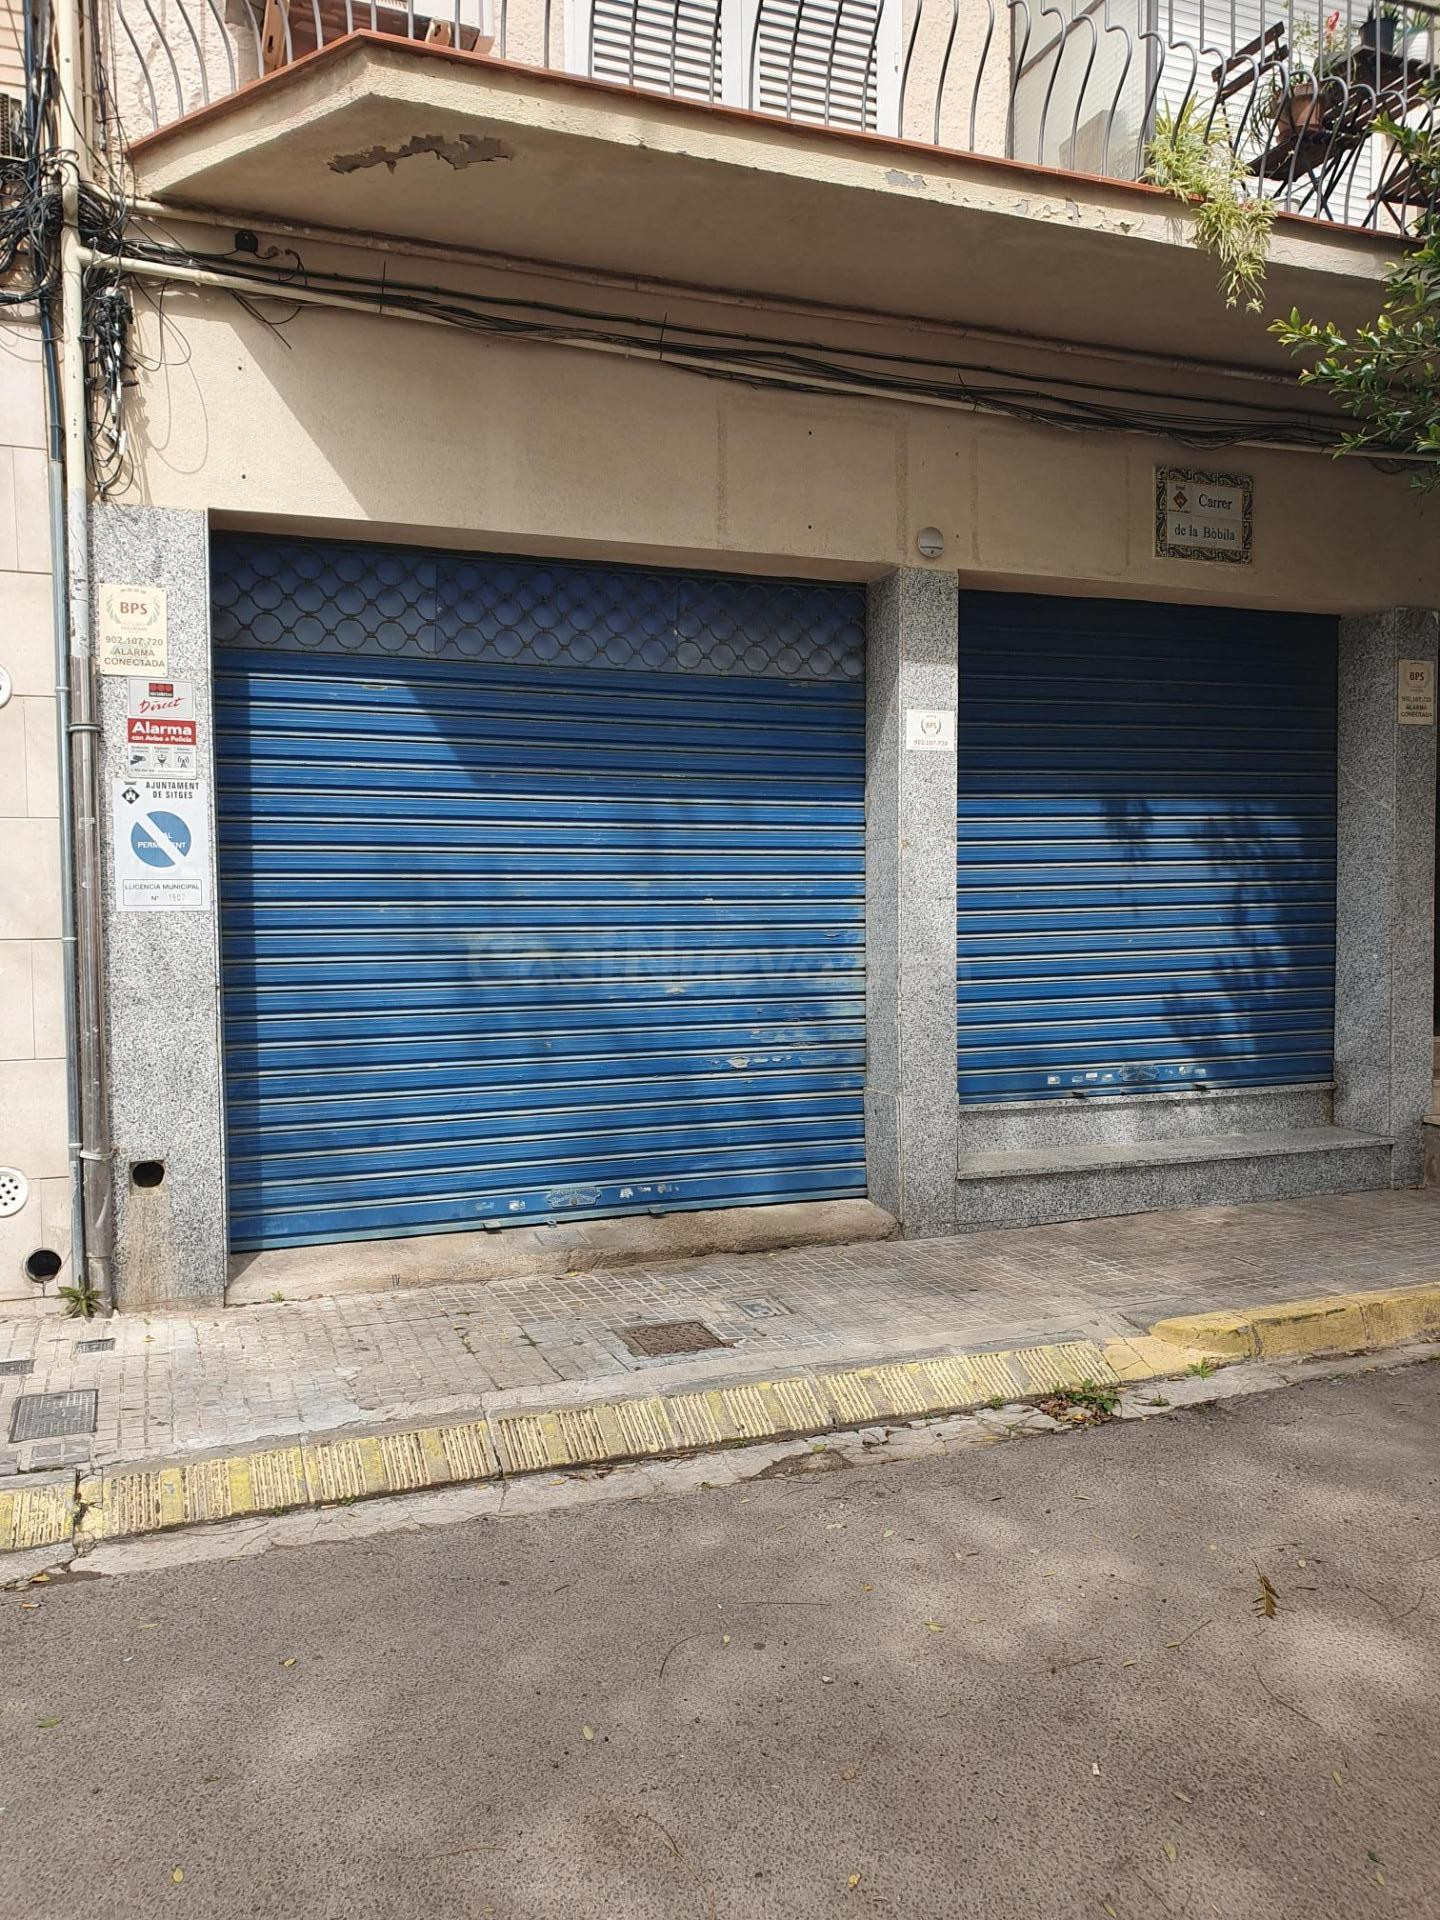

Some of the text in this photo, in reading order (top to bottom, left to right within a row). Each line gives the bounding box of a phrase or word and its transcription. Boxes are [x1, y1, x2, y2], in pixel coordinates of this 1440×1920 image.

[1199, 493, 1232, 510] Carrer
[1174, 523, 1186, 536] de
[1189, 524, 1198, 537] la
[119, 601, 148, 615] BPS
[113, 647, 155, 657] ALARMA
[104, 657, 165, 668] CONECTADA
[1409, 671, 1425, 681] BPS
[131, 721, 192, 736] Alarma
[146, 782, 199, 790] AJUNTAMENT
[153, 791, 163, 799] DE
